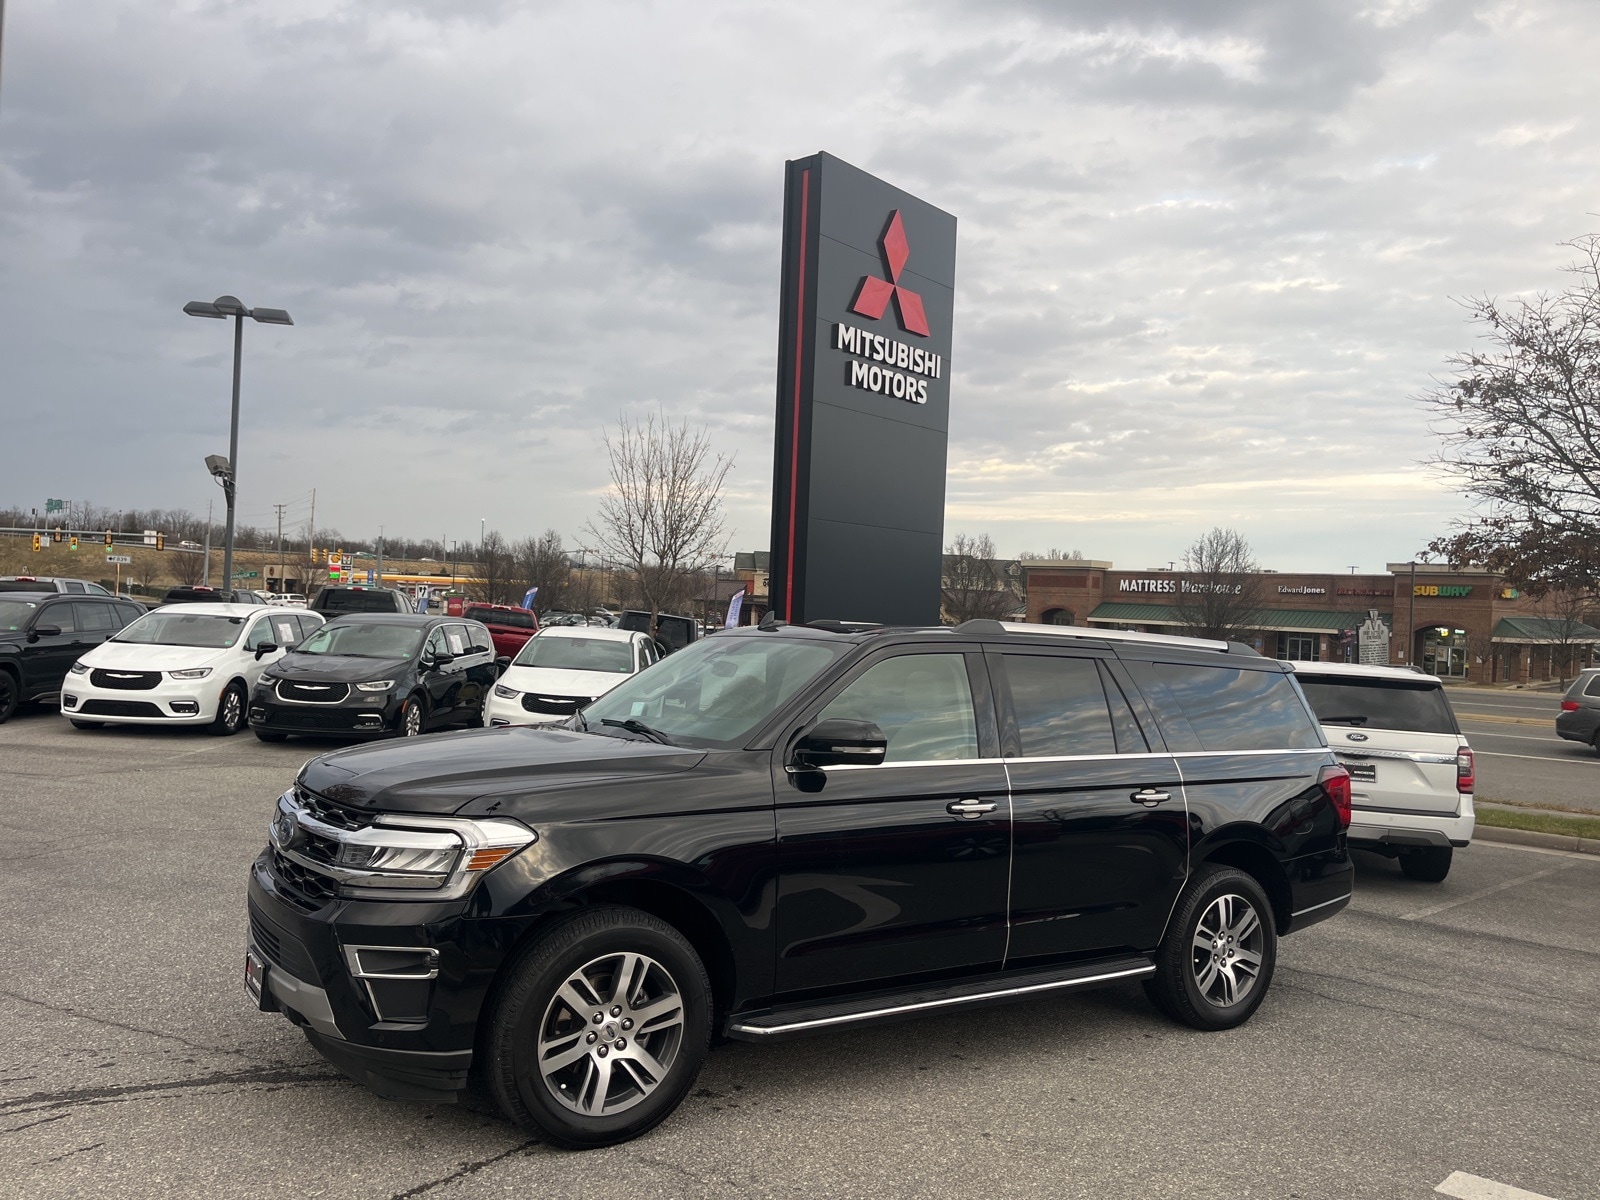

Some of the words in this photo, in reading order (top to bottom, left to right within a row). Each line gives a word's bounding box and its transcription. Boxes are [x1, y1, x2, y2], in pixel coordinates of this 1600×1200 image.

[837, 322, 941, 379] MITSUBISHI
[851, 359, 928, 405] MOTORS
[1119, 579, 1176, 593] MATTRESS
[1278, 585, 1303, 594] Edward
[1303, 586, 1326, 594] Jones
[1413, 585, 1469, 597] SUBWAY
